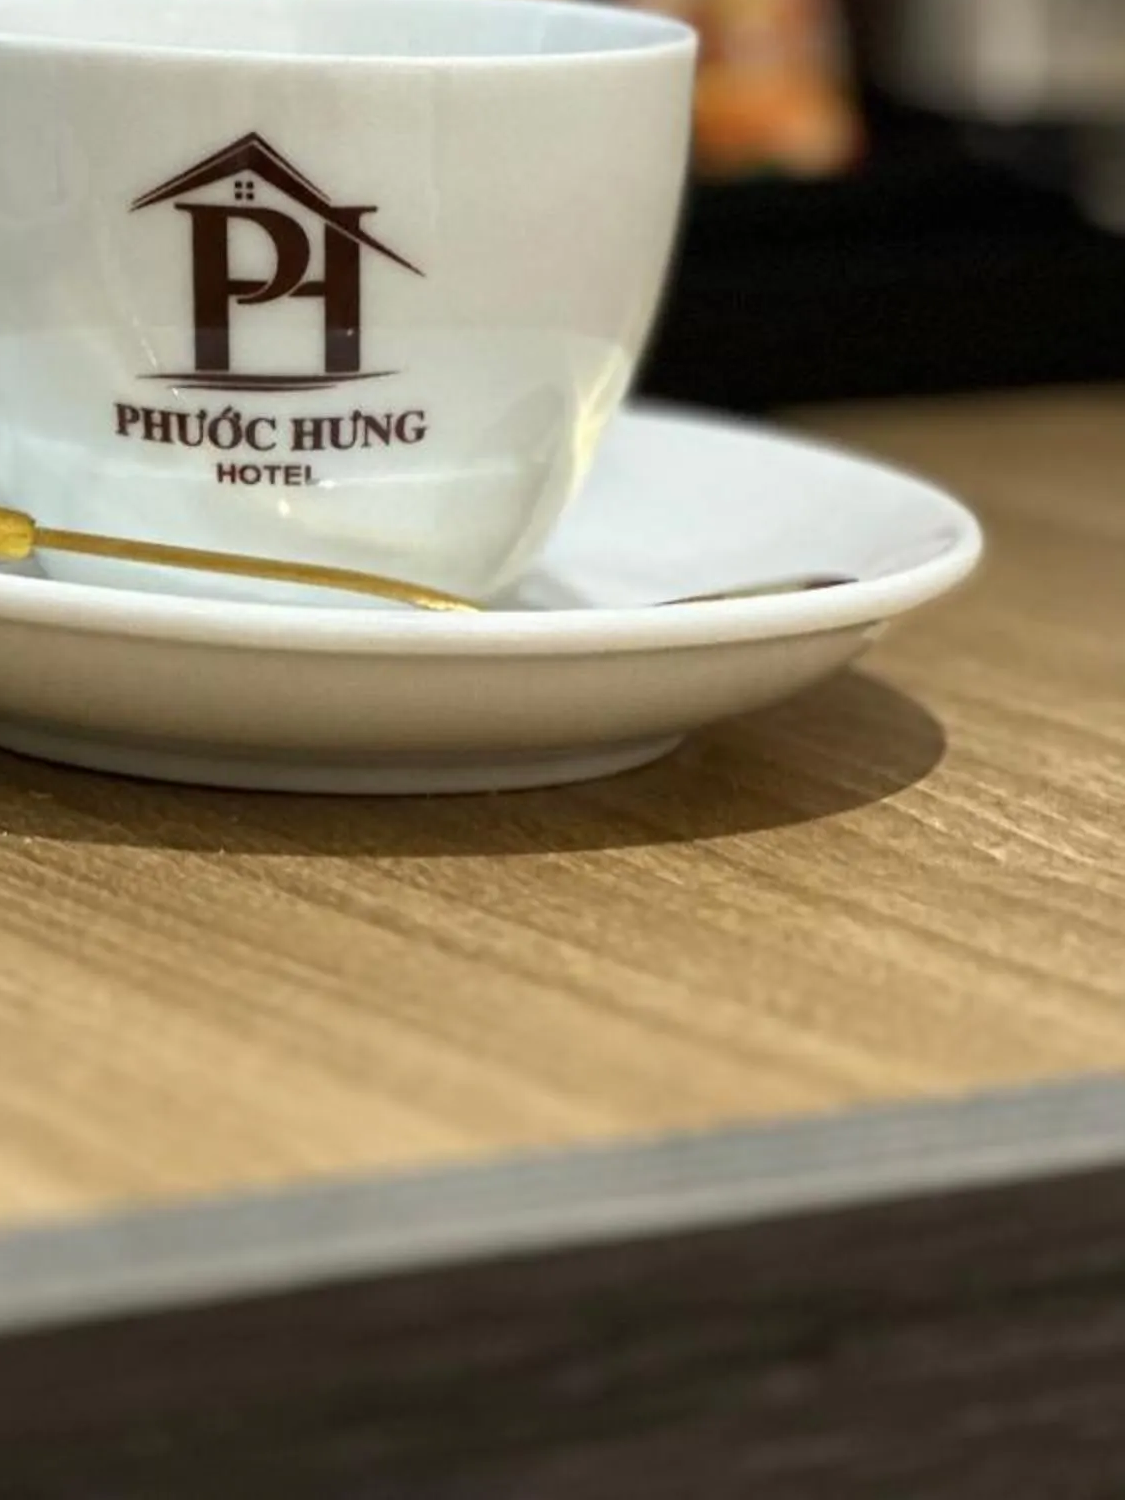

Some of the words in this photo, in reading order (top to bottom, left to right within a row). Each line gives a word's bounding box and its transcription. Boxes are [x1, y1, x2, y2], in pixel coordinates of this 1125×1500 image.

[114, 403, 276, 451] PHƯỚC
[290, 409, 428, 451] HƯNG
[216, 462, 320, 486] HOTEL
